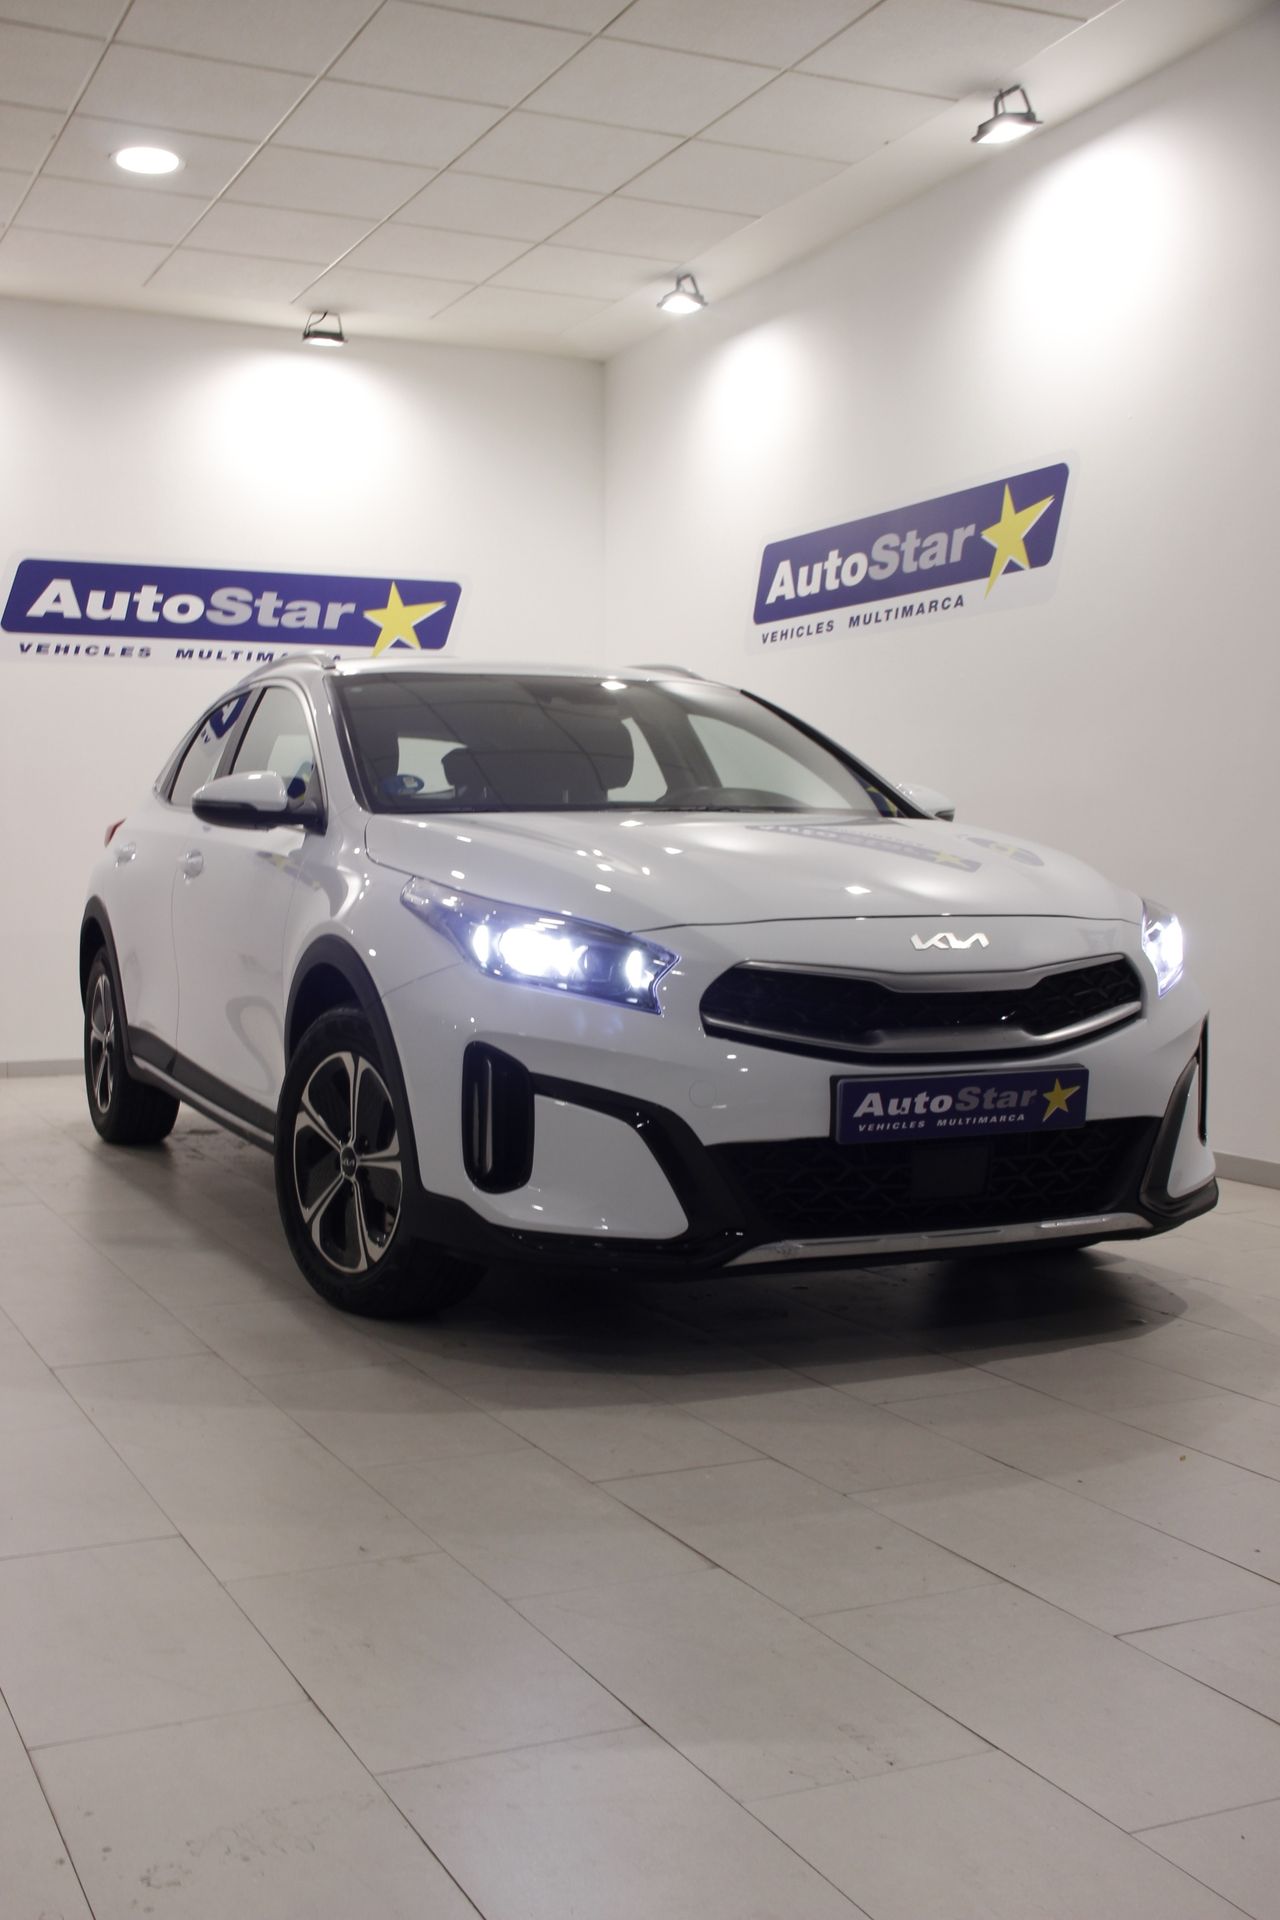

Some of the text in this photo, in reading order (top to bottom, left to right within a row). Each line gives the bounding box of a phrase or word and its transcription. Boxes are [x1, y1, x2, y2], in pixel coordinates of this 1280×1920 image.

[765, 523, 976, 605] AutoStar
[26, 578, 356, 630] AutoStar
[761, 594, 964, 644] VEHICLES MULTIMARCA
[19, 643, 152, 659] VEHICLES
[853, 1086, 1038, 1118] AutoStar
[858, 1113, 1026, 1132] VEHICLES MULTIMARCA
